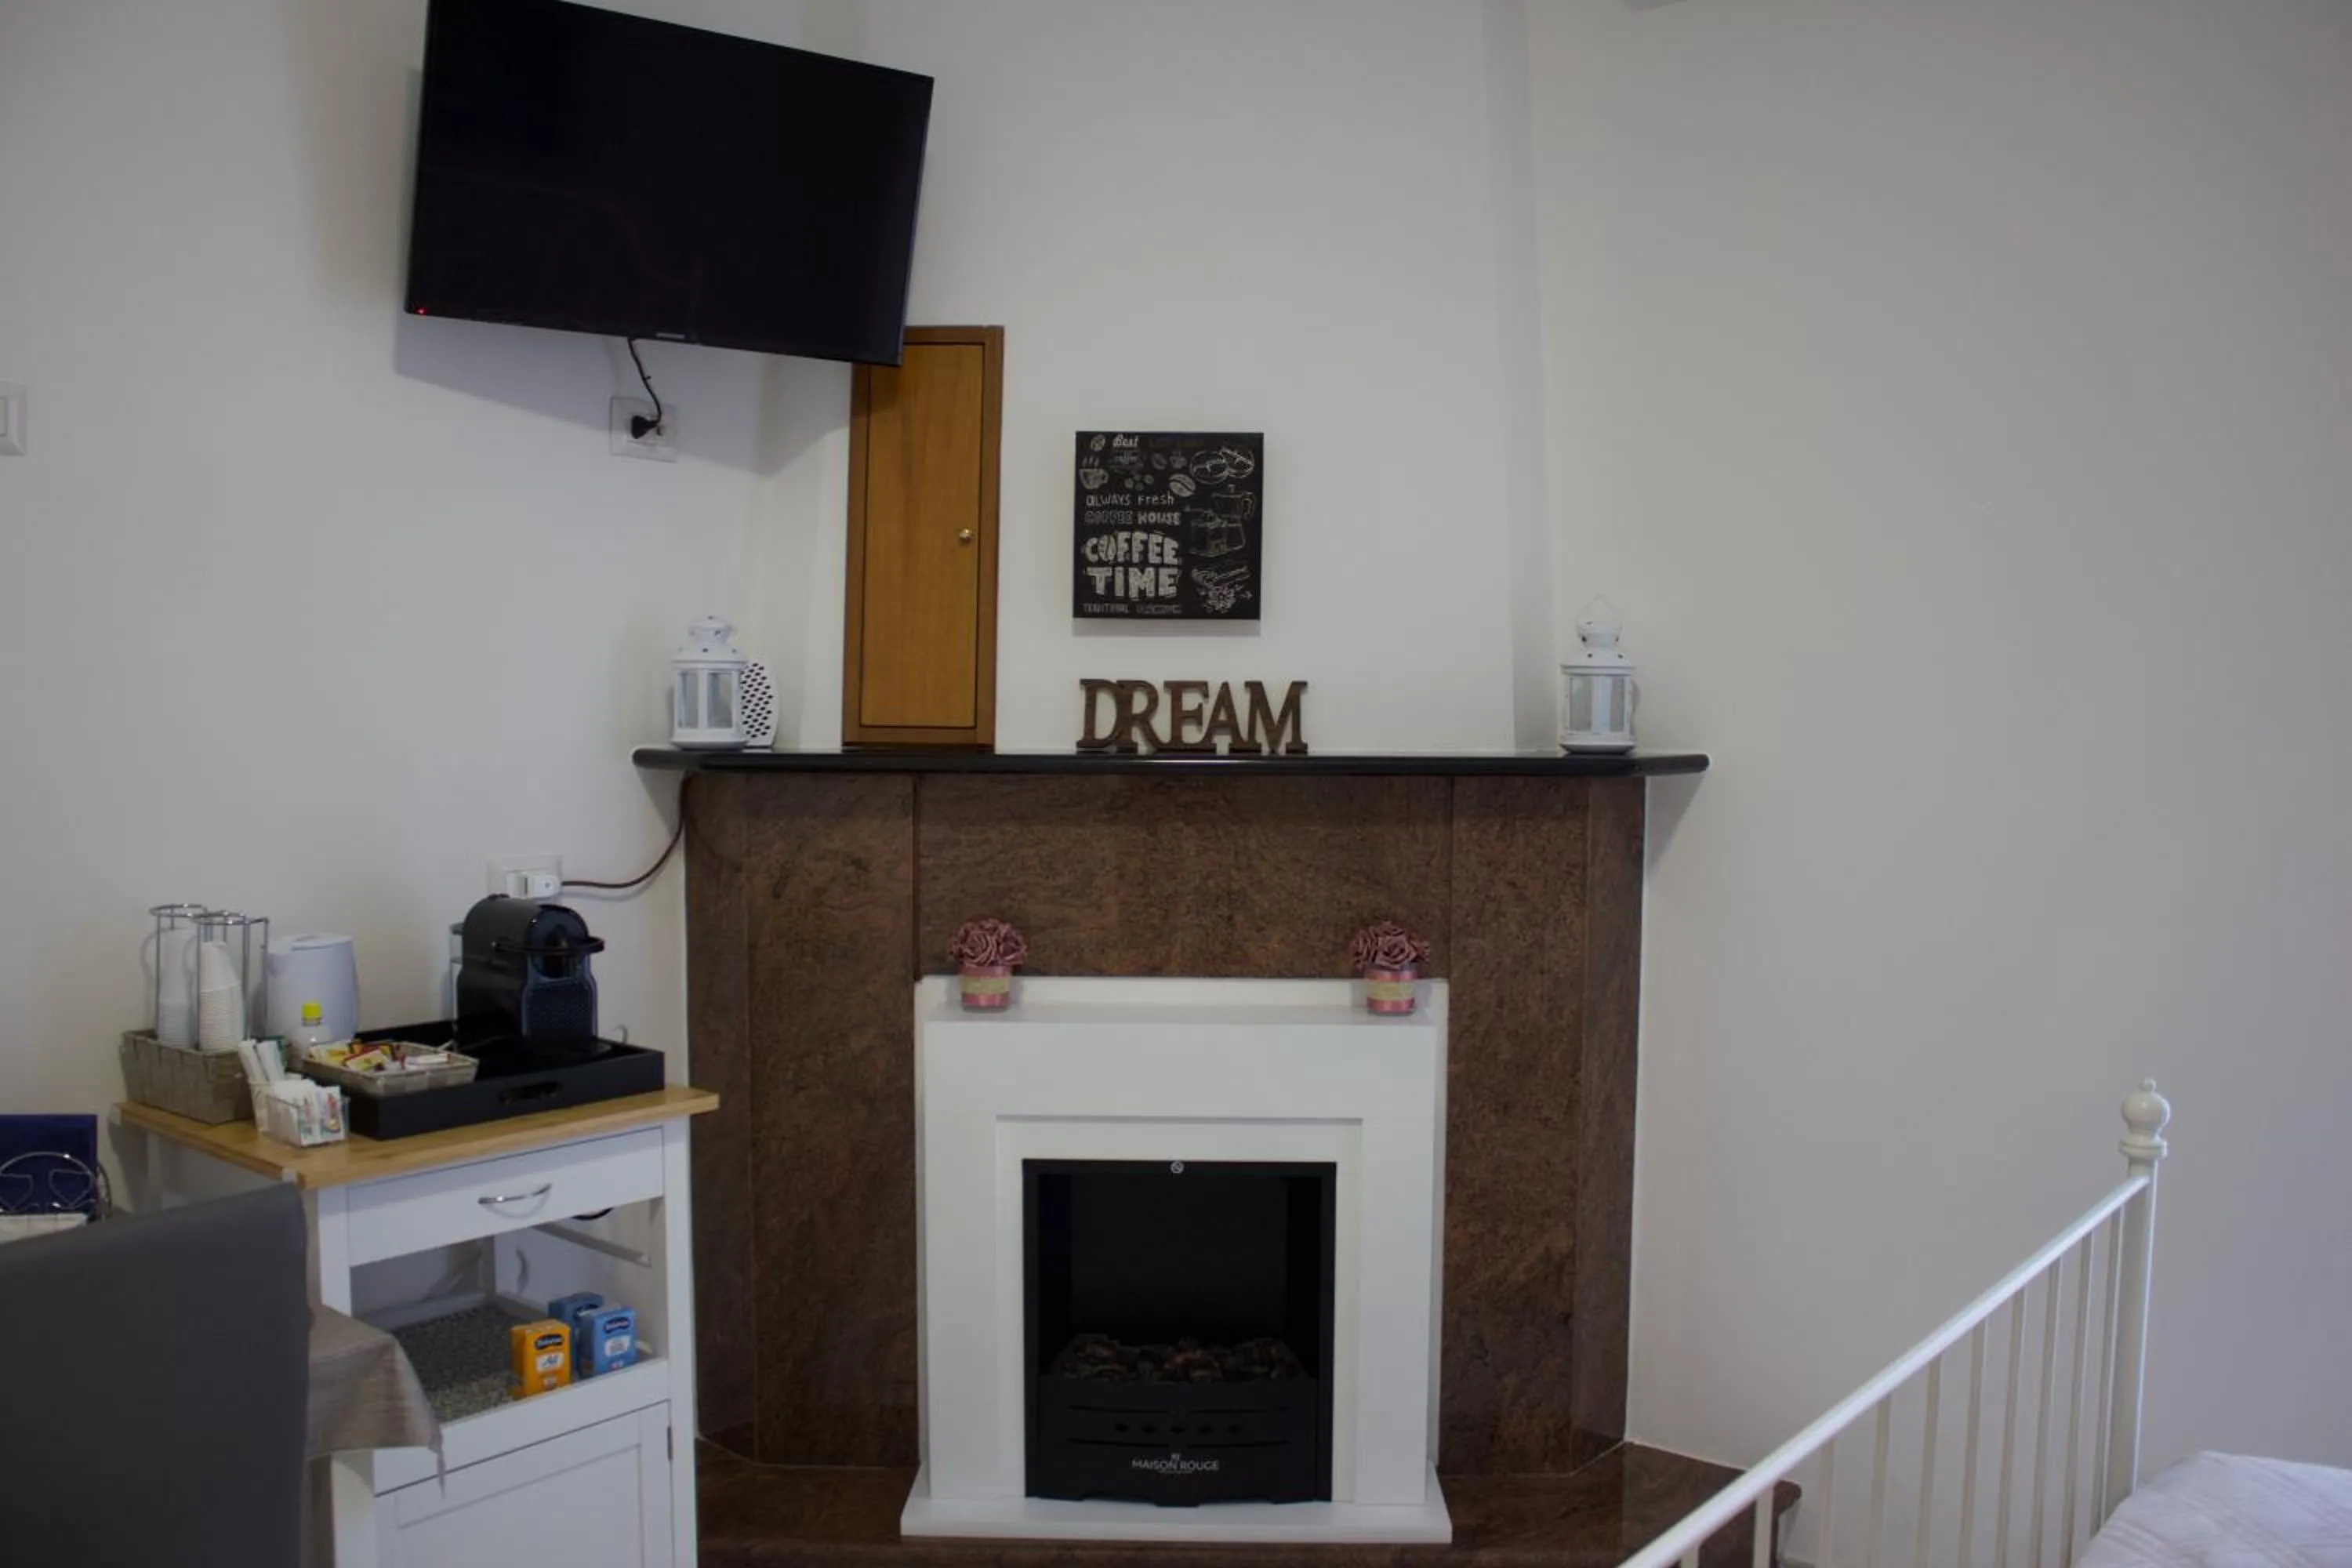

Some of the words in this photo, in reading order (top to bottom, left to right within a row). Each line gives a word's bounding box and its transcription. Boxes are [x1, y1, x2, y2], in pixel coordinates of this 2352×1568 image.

[1138, 511, 1181, 525] HOUSE
[1084, 531, 1180, 564] COFFEE
[1086, 566, 1179, 599] TIME
[1076, 679, 1308, 754] DREAM
[1131, 1458, 1177, 1470] MAISON
